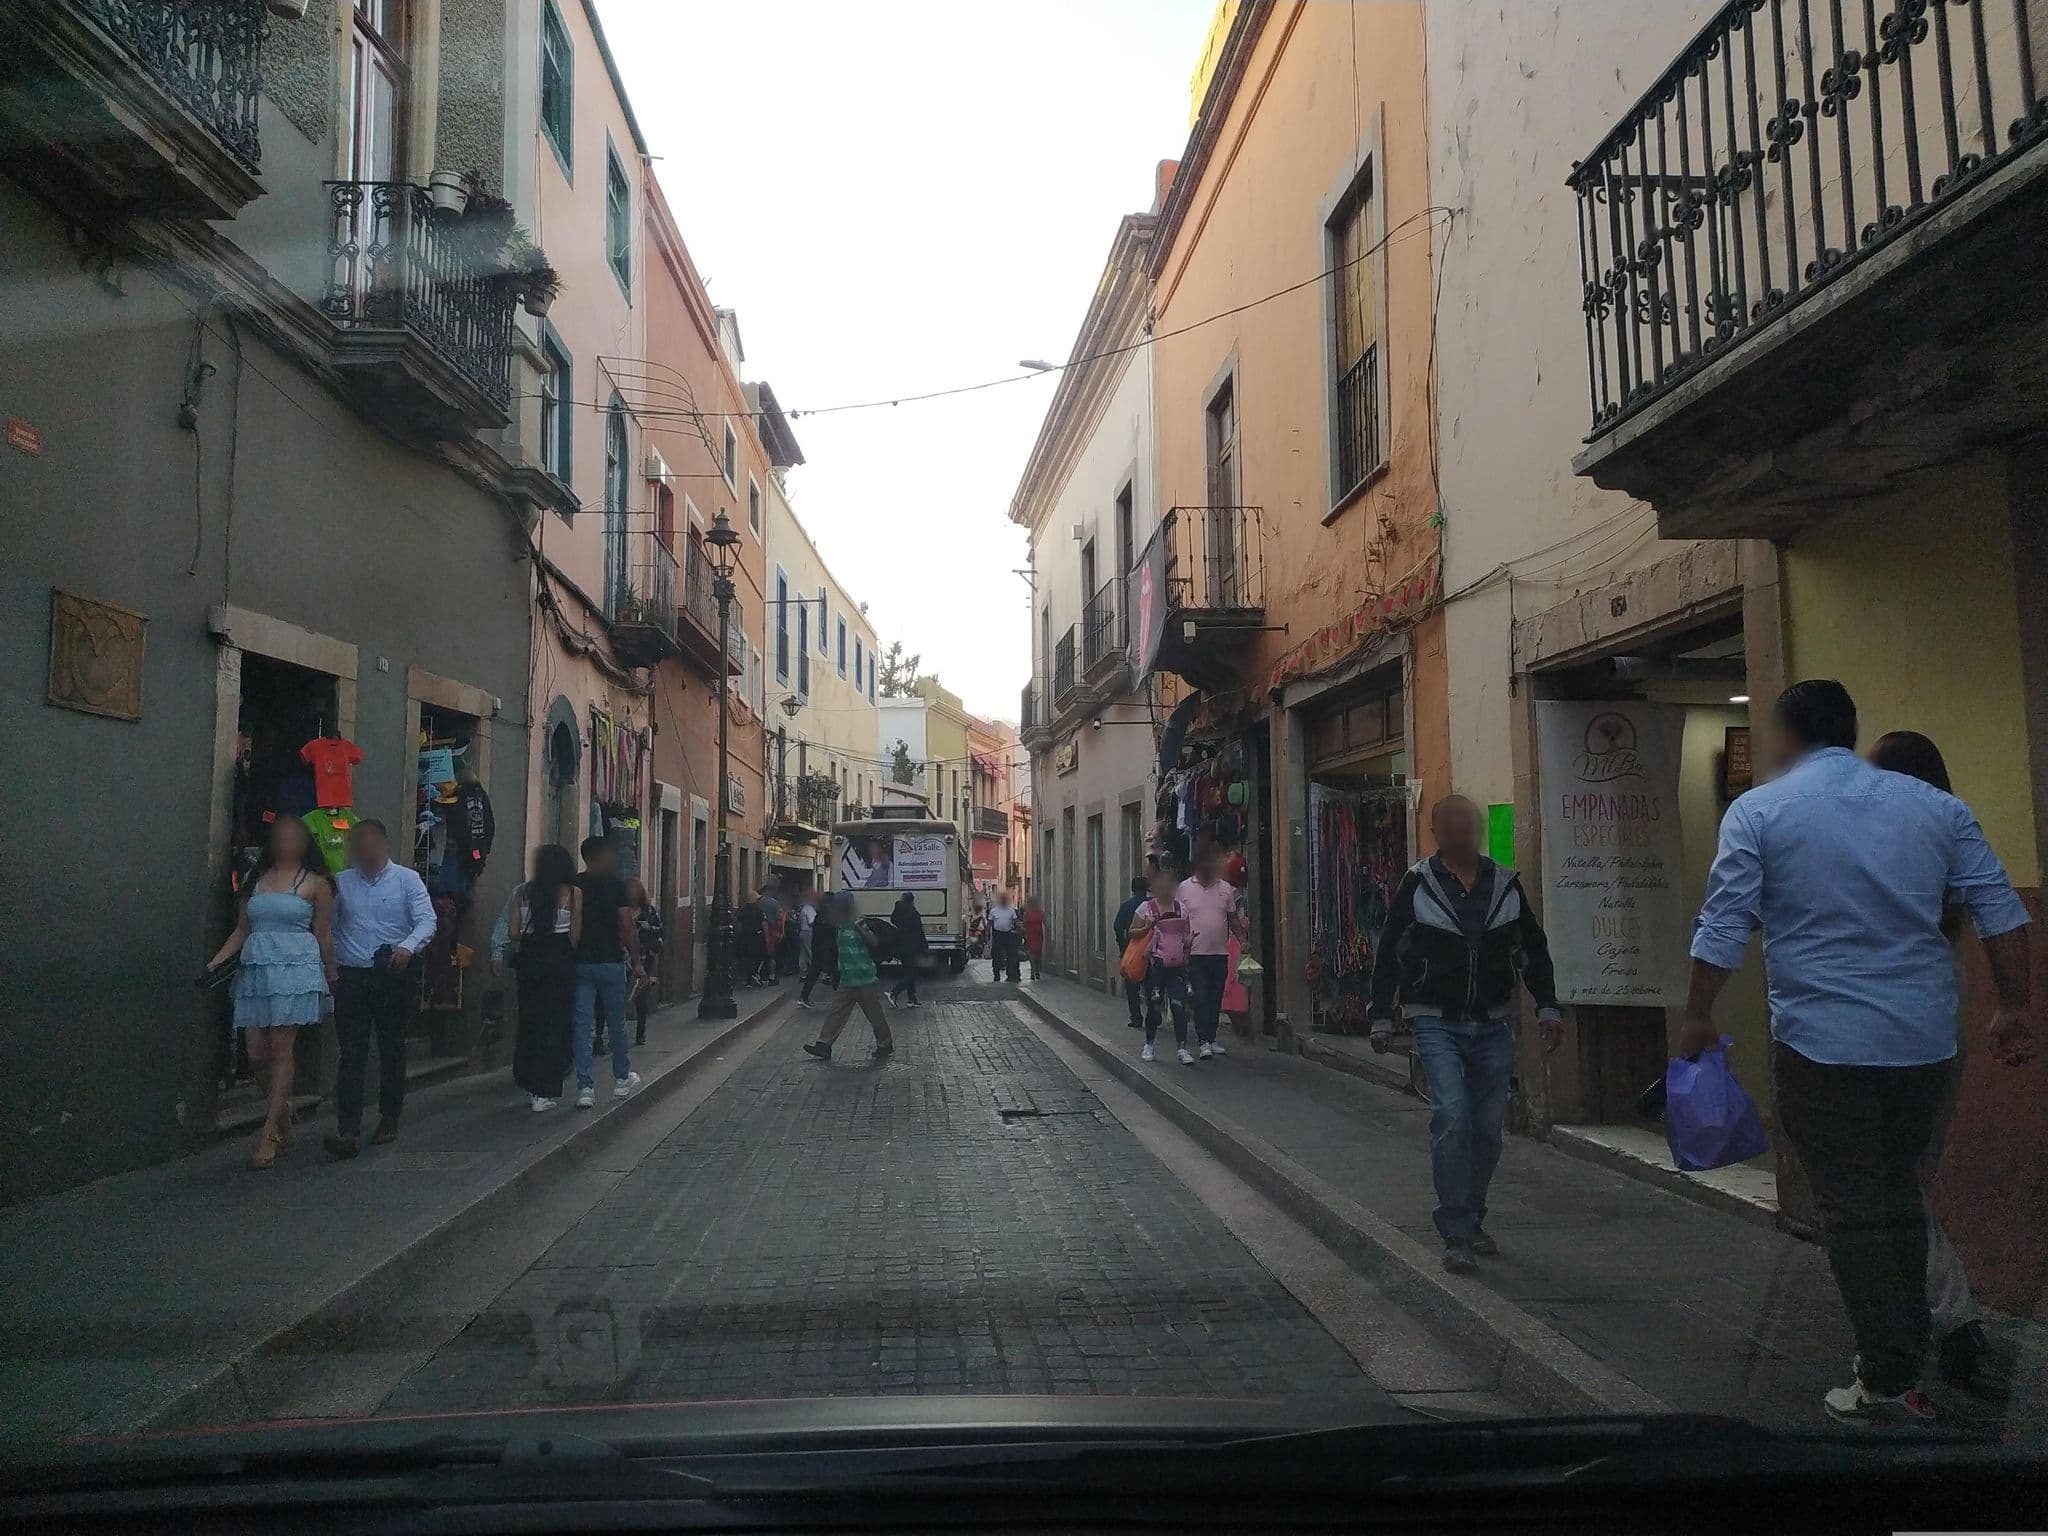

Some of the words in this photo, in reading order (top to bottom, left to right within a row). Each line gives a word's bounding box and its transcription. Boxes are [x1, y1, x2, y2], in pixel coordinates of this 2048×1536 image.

[1561, 794, 1661, 822] EMPANADAS
[1573, 825, 1649, 847] ESPECIALES
[923, 842, 941, 851] Salle
[1598, 896, 1637, 909] Nutella
[1593, 916, 1641, 938] DULCES
[1600, 963, 1639, 977] Fresa
[1614, 984, 1630, 995] 25
